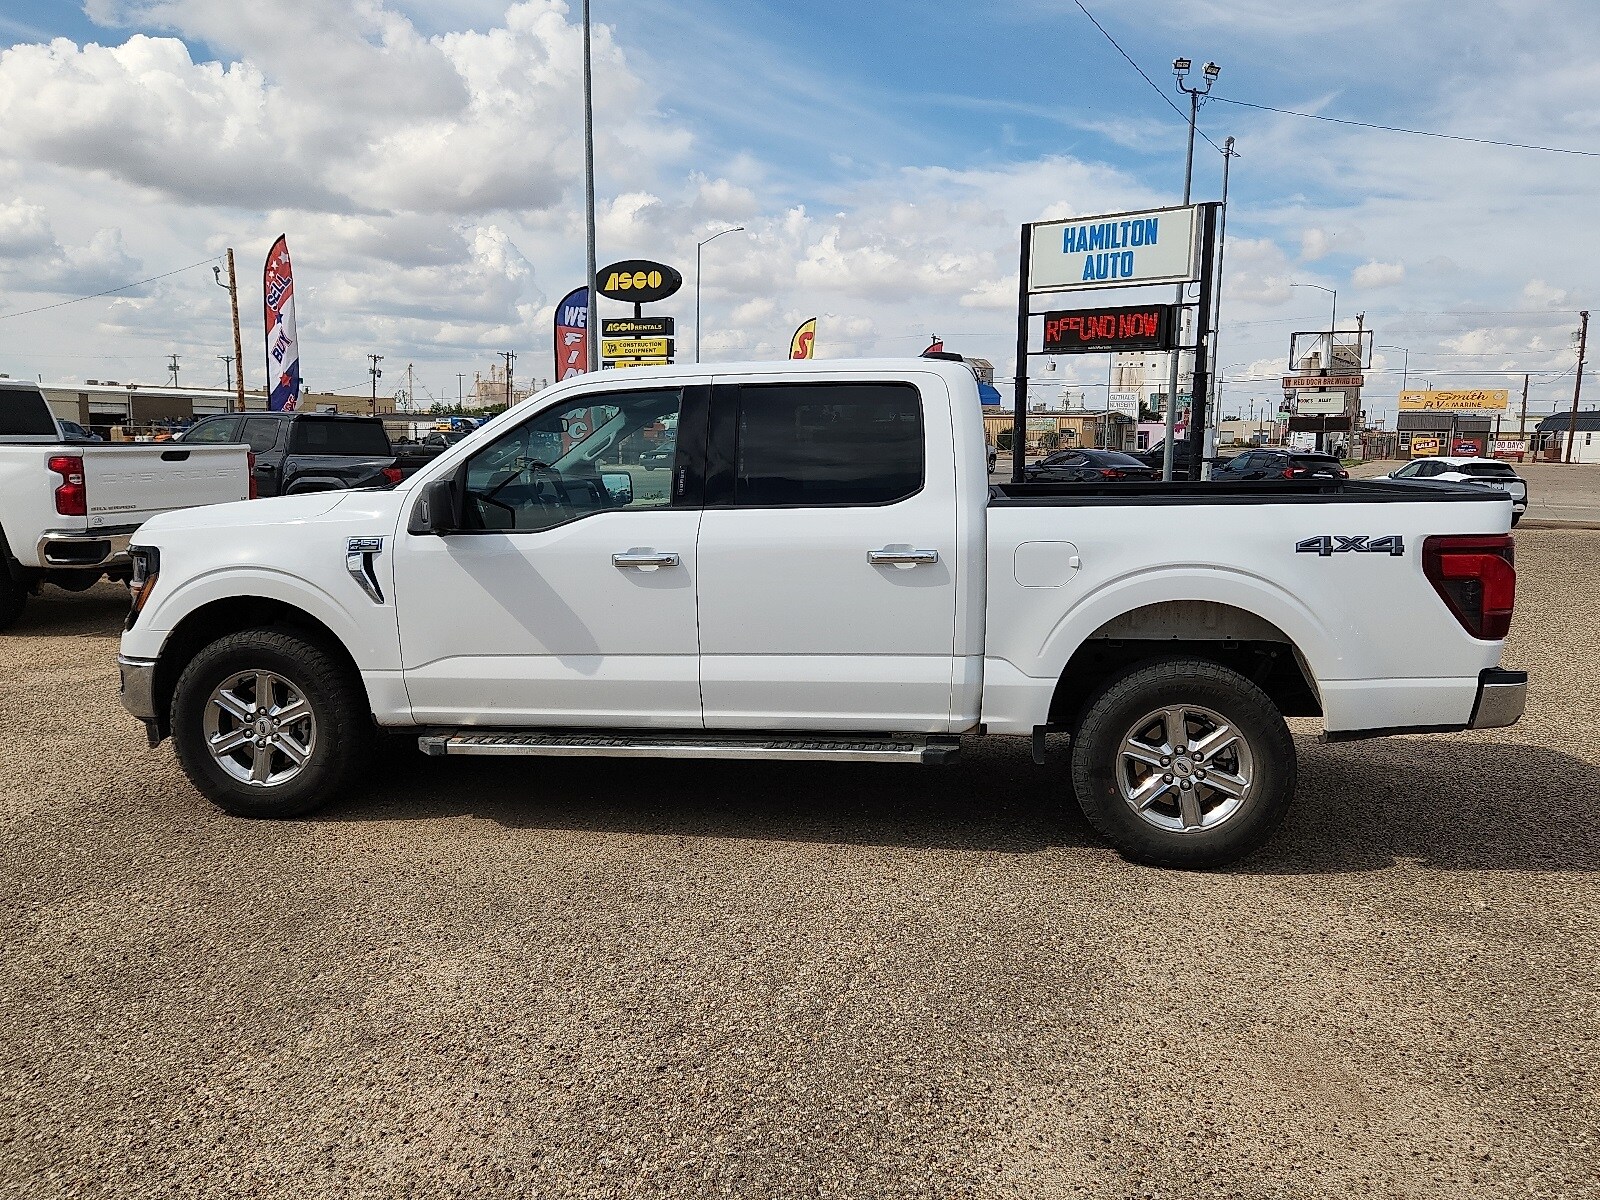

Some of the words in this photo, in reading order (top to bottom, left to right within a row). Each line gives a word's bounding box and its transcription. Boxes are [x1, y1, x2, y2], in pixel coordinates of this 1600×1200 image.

[1063, 218, 1158, 253] HAMILTON
[1082, 251, 1134, 280] AUTO
[604, 271, 662, 291] ASCO
[267, 274, 292, 311] SELL
[564, 306, 587, 328] WE
[1118, 313, 1159, 338] NOW
[271, 327, 293, 364] BUY
[1323, 378, 1350, 386] BREWING
[1434, 391, 1488, 401] Smith
[1496, 441, 1506, 449] 90
[1507, 441, 1524, 449] DAYS
[100, 467, 240, 485] CHEVROLET
[91, 504, 136, 512] SILVERADO
